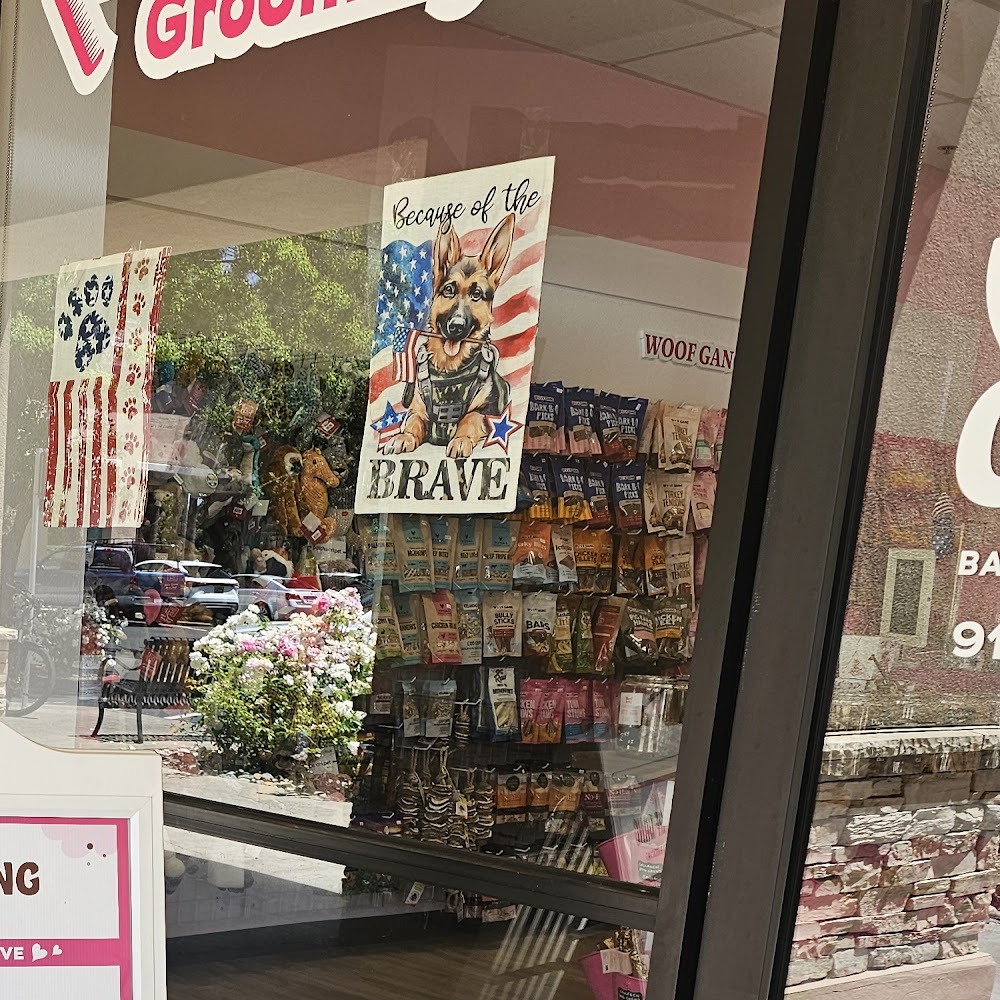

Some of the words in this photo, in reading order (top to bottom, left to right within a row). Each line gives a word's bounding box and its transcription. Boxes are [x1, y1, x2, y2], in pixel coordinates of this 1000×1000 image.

[393, 197, 466, 235] Because
[471, 186, 497, 223] of
[502, 178, 542, 215] the
[645, 334, 697, 361] WOOF
[699, 345, 734, 369] GAN
[367, 457, 510, 501] BRAVE
